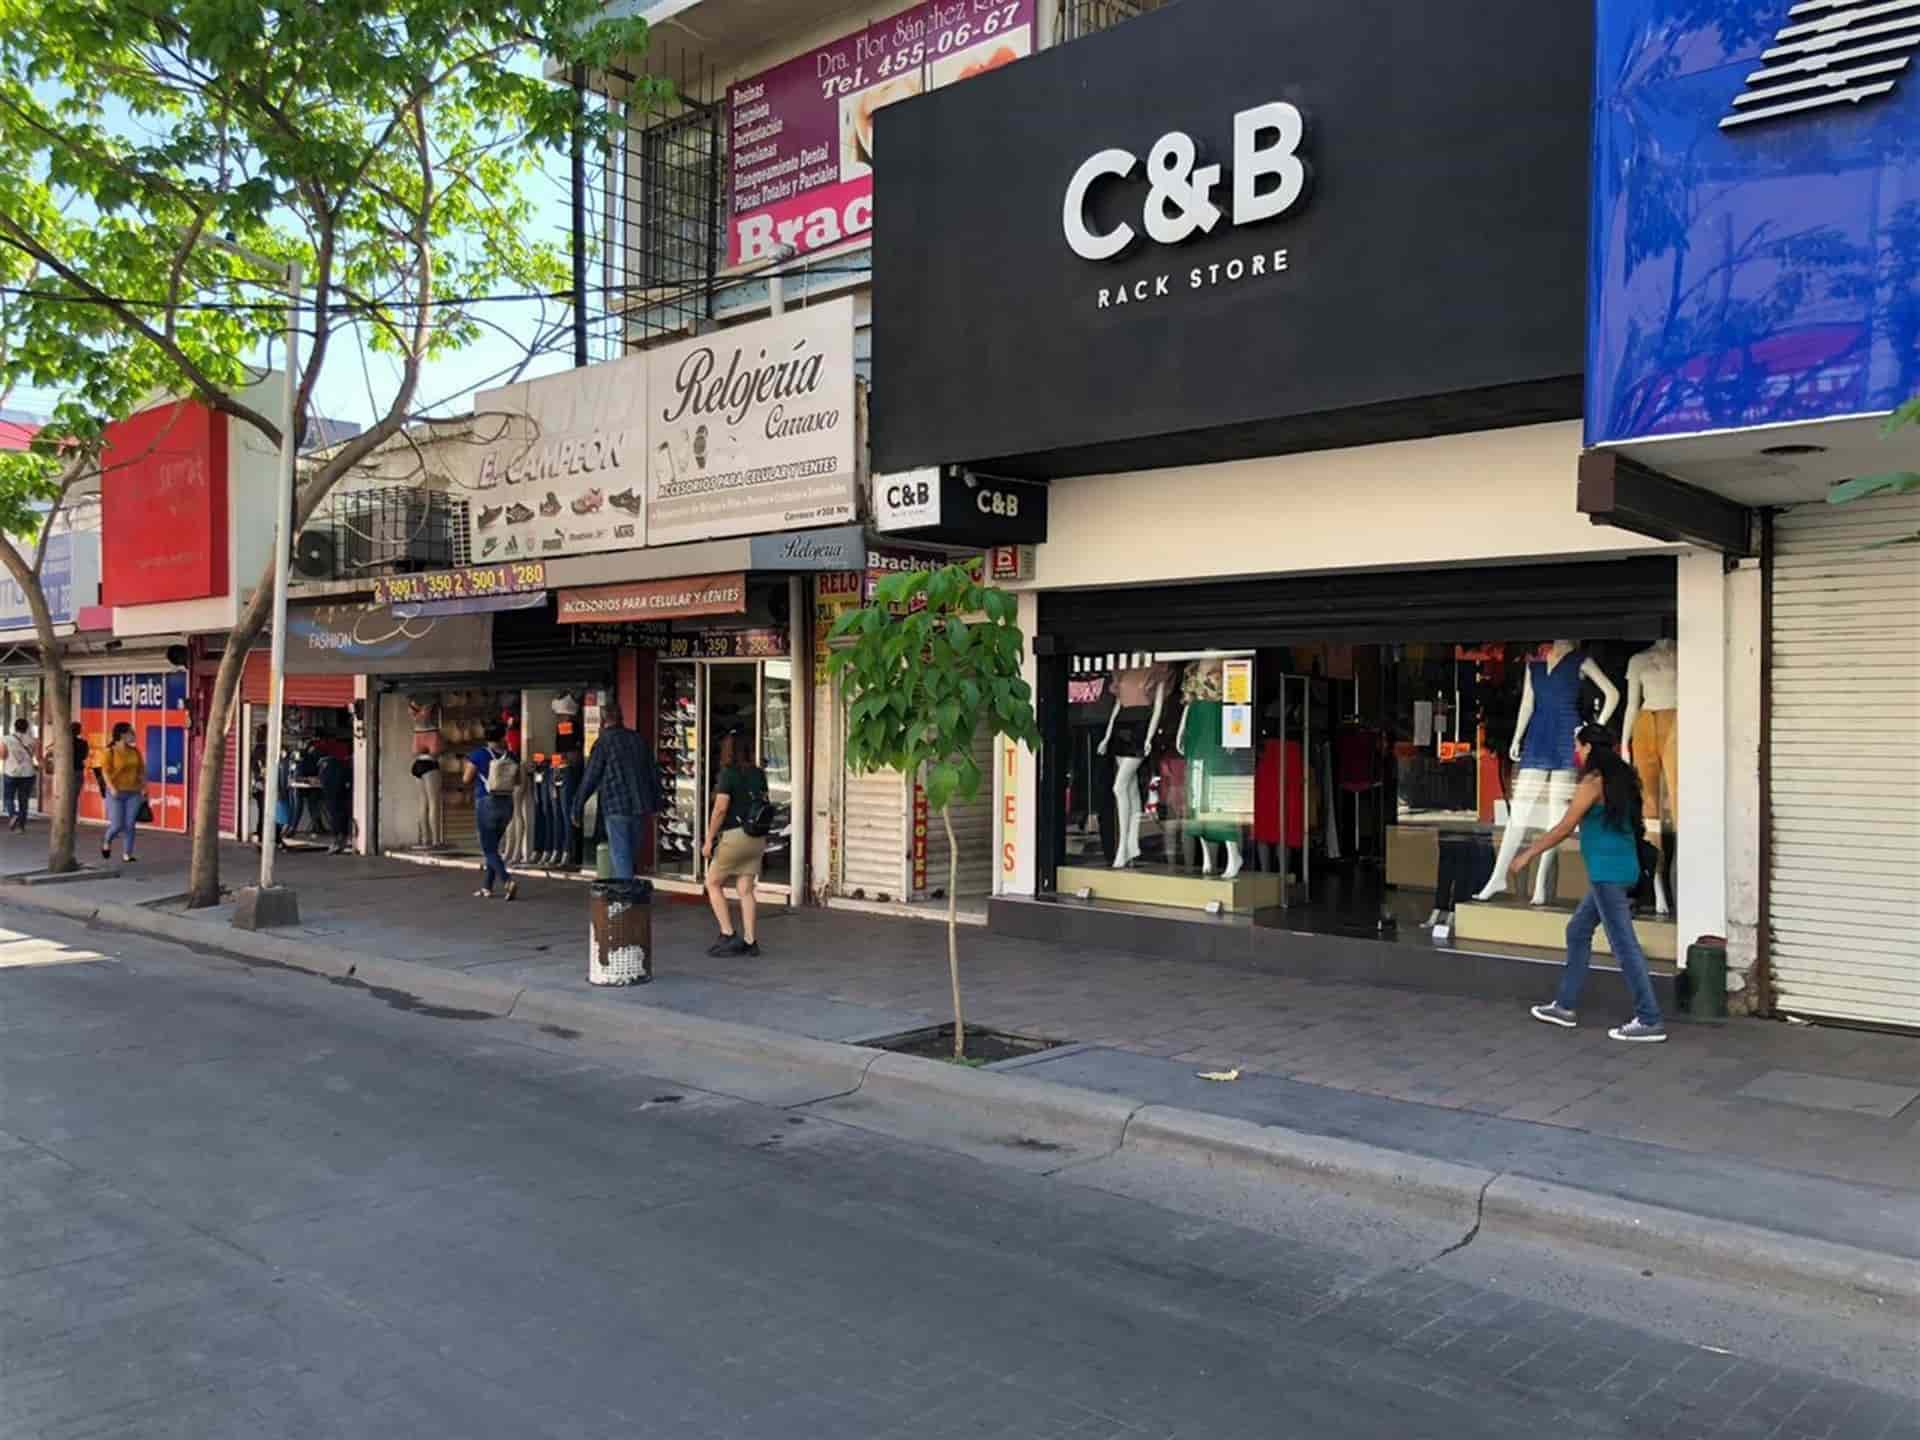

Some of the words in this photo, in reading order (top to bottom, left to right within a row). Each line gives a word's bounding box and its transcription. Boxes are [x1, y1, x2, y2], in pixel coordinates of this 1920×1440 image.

[822, 67, 869, 99] Tel.
[877, 1, 1020, 77] 455-06-67
[800, 142, 829, 168] Dental
[1063, 101, 1305, 260] C&B
[1097, 274, 1170, 308] RACK
[1190, 249, 1288, 288] STORE
[663, 338, 824, 425] Relojería
[764, 403, 840, 440] Carrasco
[657, 477, 716, 499] ACCESORIOS
[716, 471, 745, 490] PARA
[745, 462, 789, 485] CELULAR
[798, 456, 838, 478] LENTES
[886, 482, 930, 510] C&B
[976, 488, 1019, 517] C&B
[562, 599, 620, 613] ACCESORIOS
[622, 597, 648, 610] PARA
[649, 592, 691, 609] CELULAR
[701, 588, 738, 605] LENTES
[308, 632, 353, 649] FASHION
[111, 676, 163, 706] Llévate
